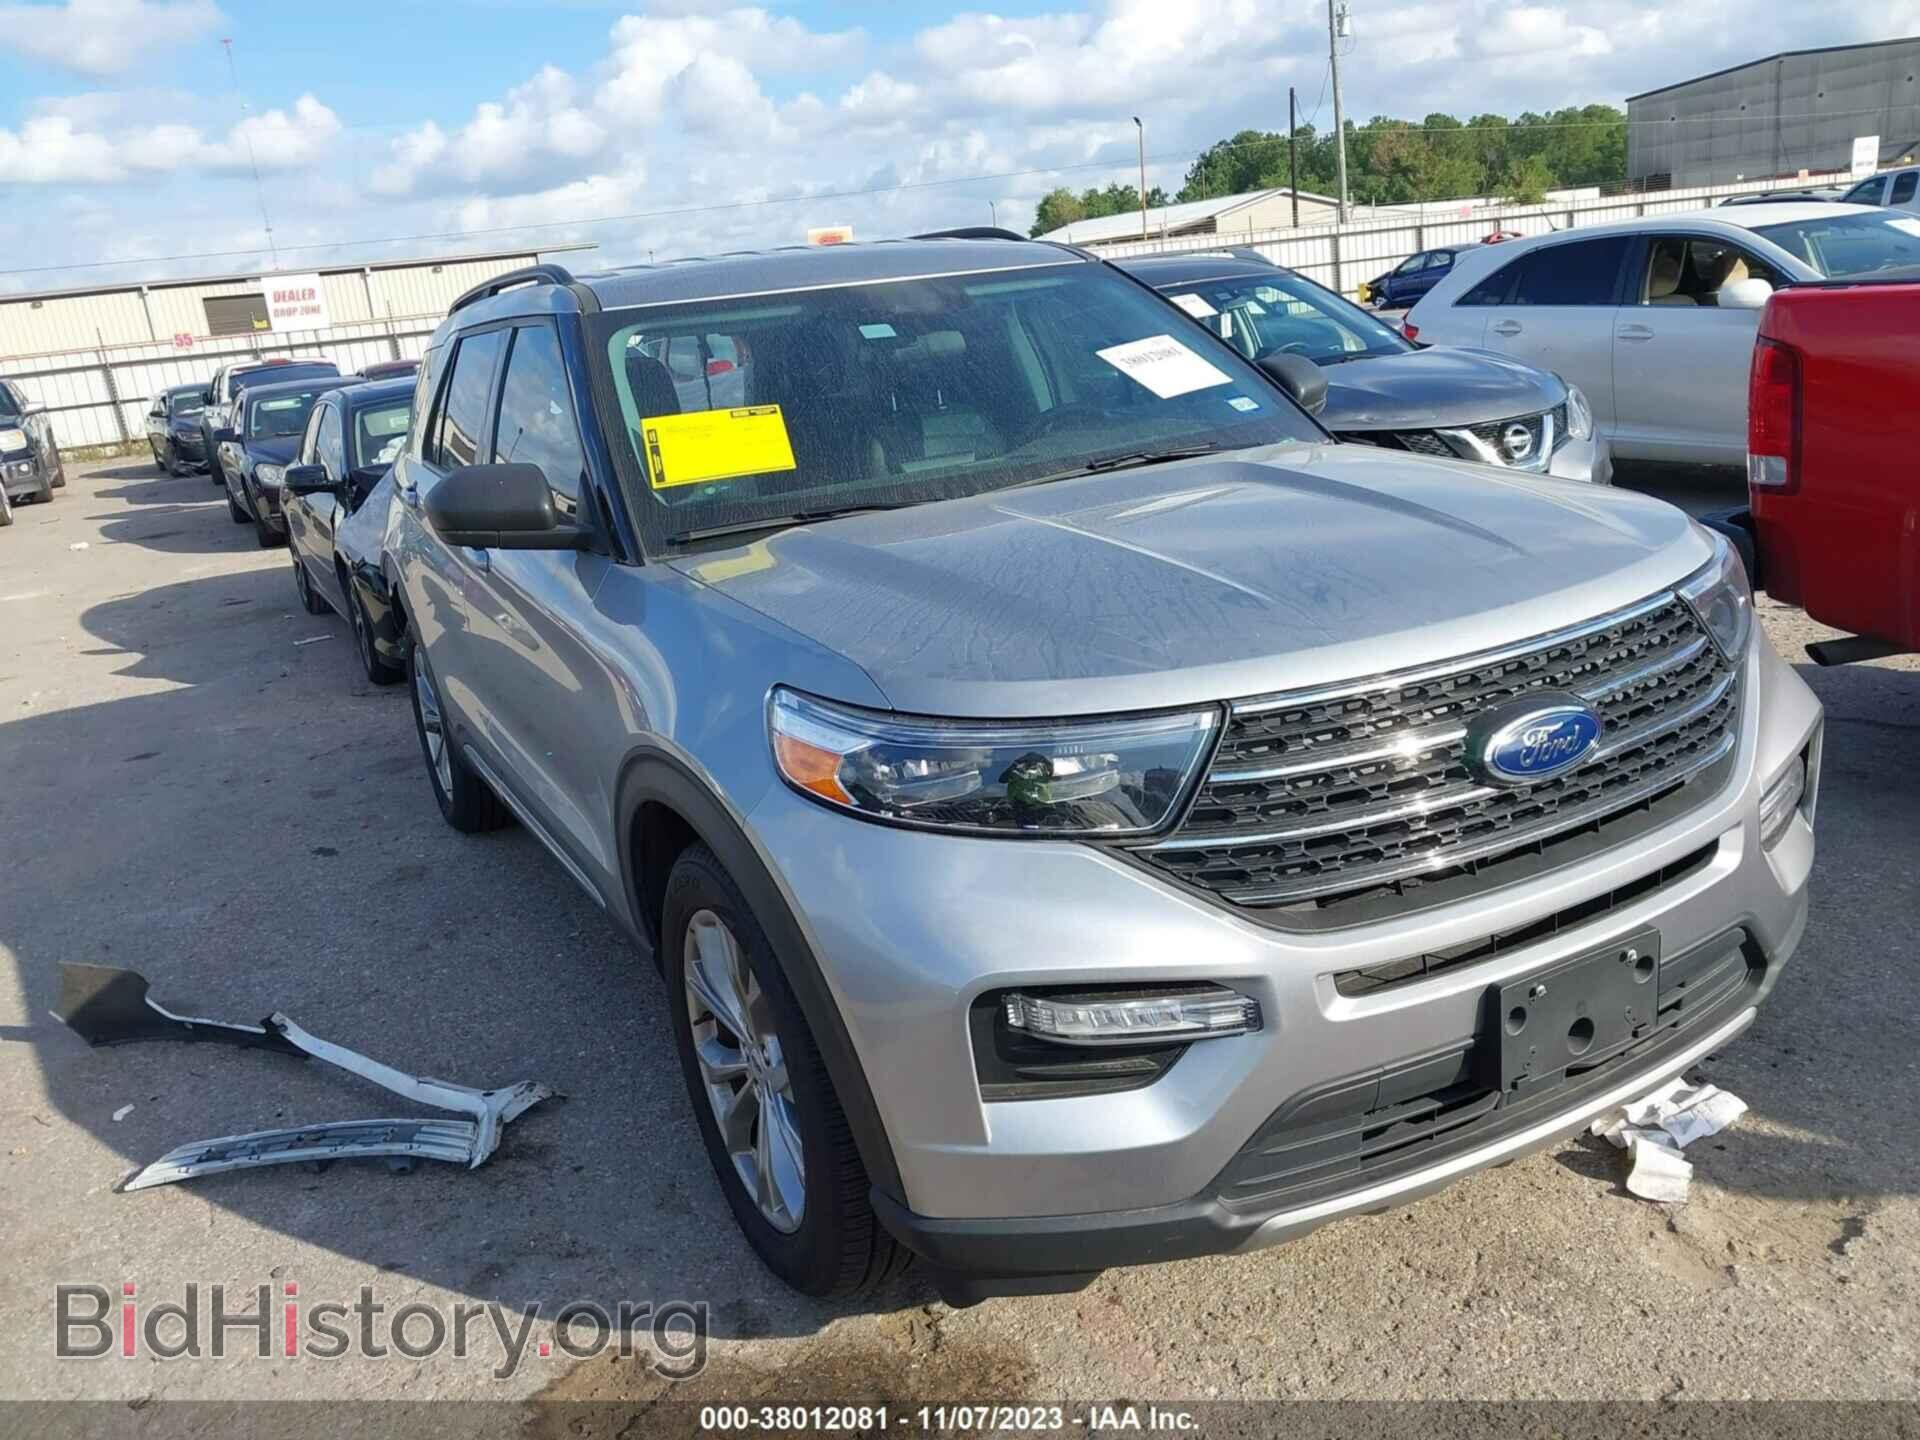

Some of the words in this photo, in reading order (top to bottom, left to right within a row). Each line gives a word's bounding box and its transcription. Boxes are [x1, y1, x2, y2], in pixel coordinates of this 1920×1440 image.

[273, 288, 316, 303] DEALER
[174, 333, 194, 347] 55
[1520, 721, 1581, 767] Ford
